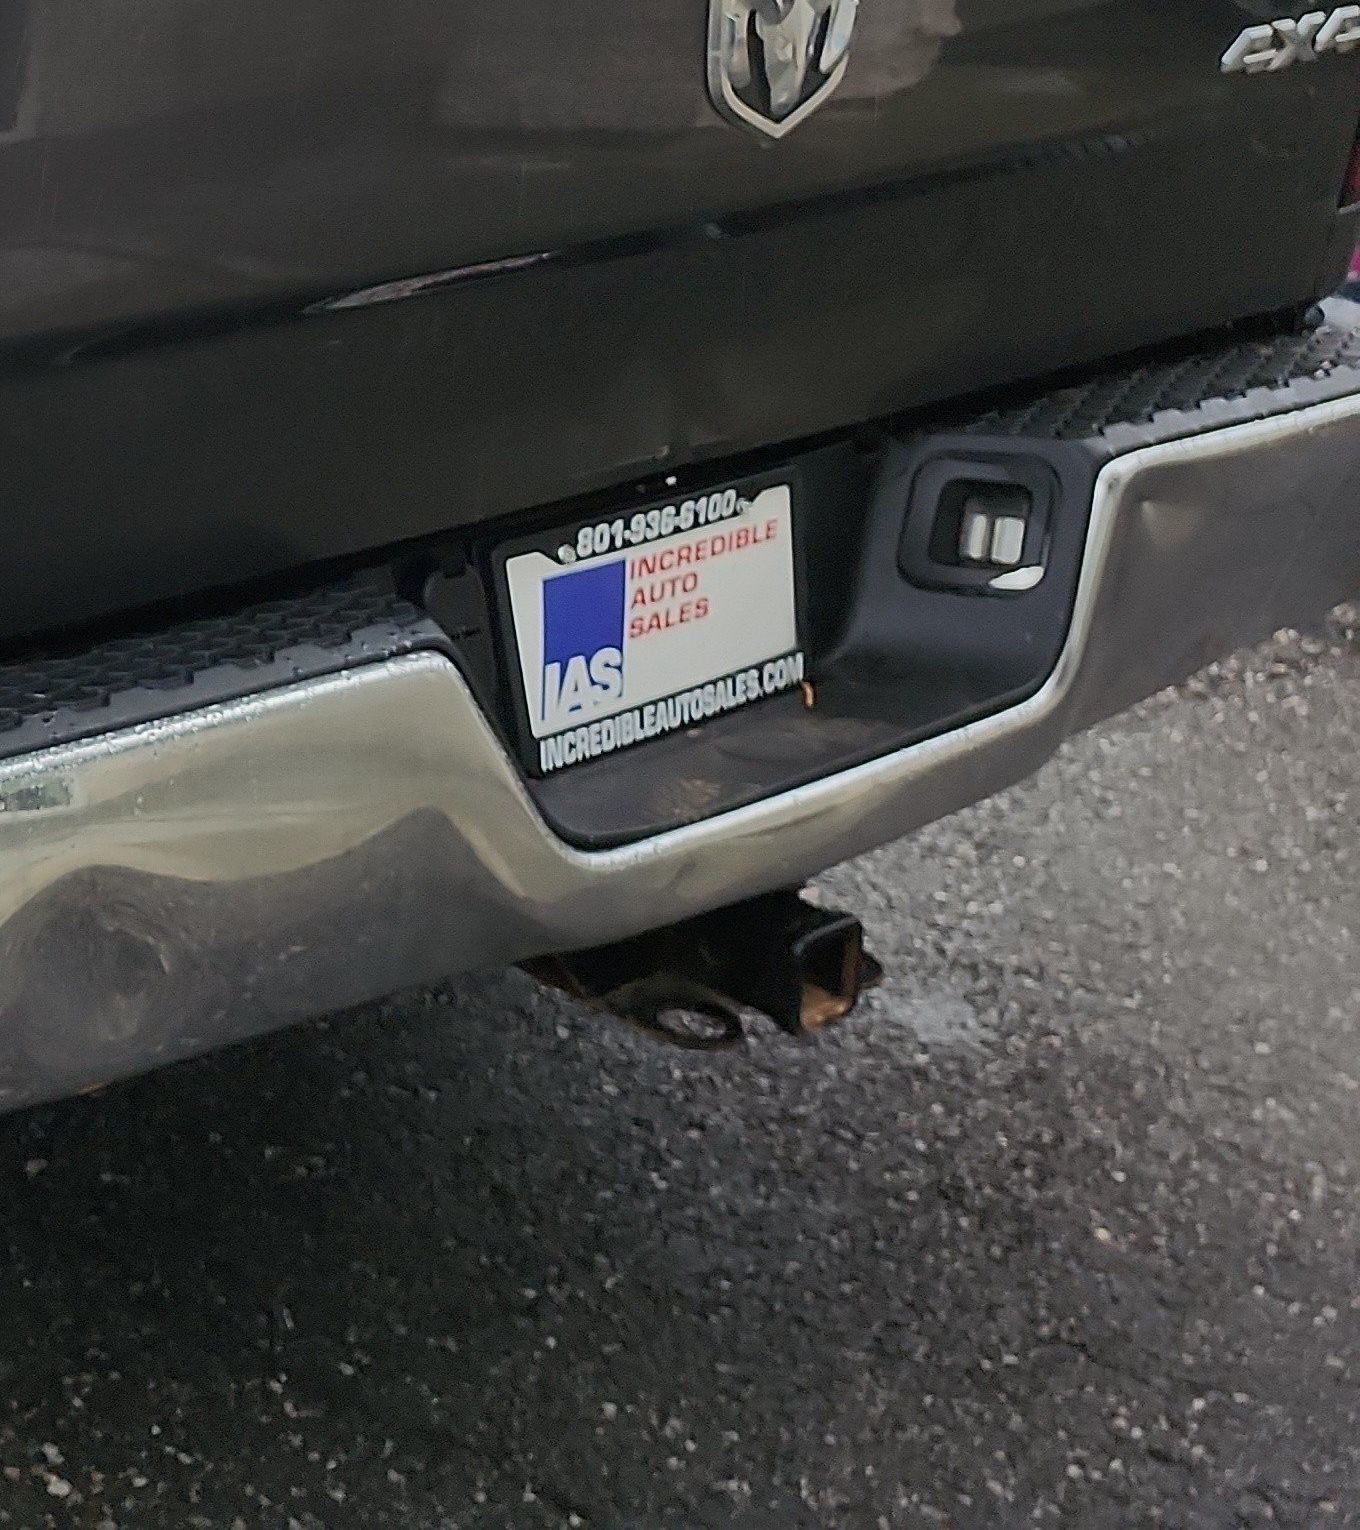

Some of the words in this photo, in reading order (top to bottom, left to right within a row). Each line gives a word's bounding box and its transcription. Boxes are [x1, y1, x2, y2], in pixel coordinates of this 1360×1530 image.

[629, 518, 779, 580] INCREDIBLE
[630, 597, 710, 639] SALES
[631, 572, 698, 610] AUTO
[540, 651, 805, 772] INCREDIBLEAUTOSALES.COM
[543, 647, 623, 721] IAS
